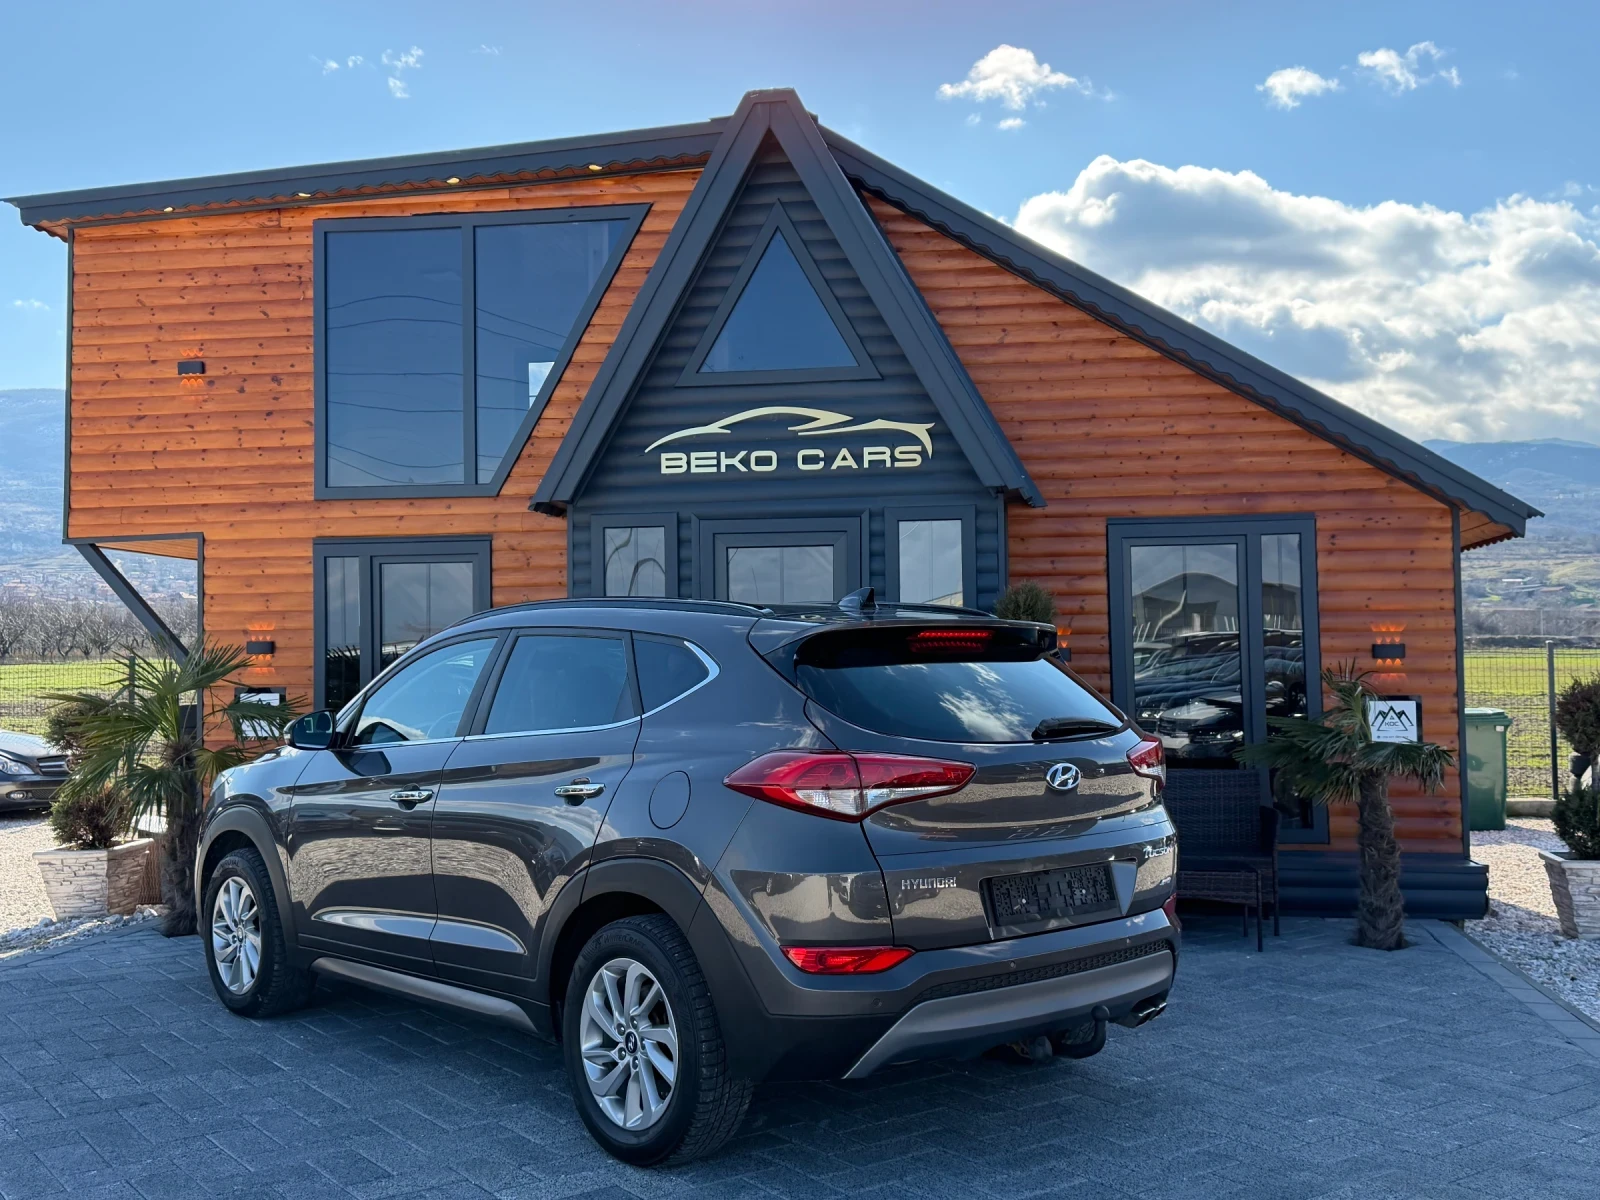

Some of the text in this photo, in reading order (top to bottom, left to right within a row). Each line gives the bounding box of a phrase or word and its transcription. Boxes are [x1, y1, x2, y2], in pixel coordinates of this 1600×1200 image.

[660, 445, 922, 474] BEKO CARS
[901, 876, 957, 890] HYUNDAI
